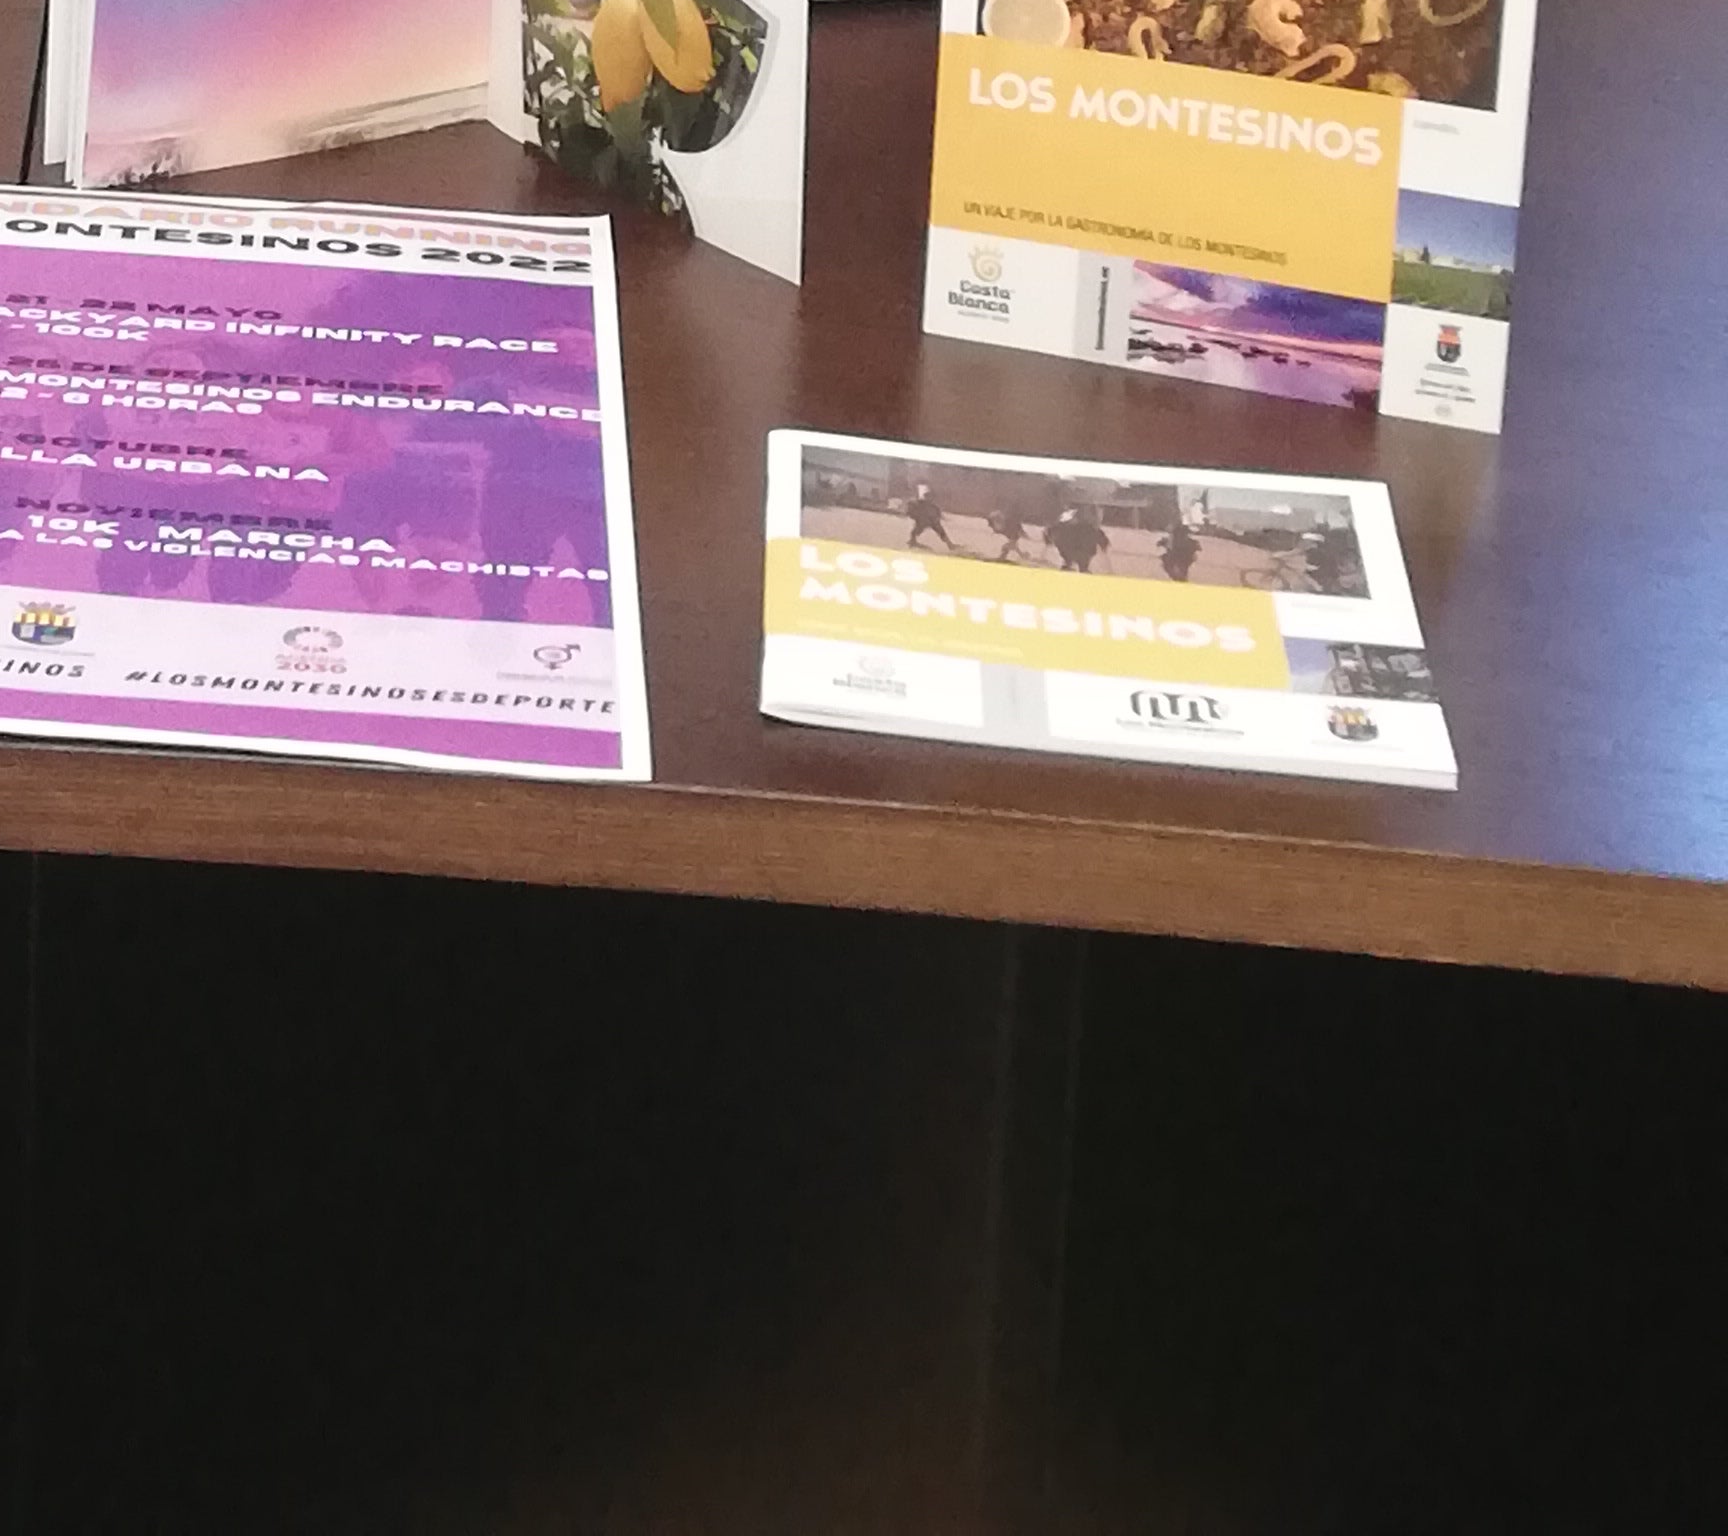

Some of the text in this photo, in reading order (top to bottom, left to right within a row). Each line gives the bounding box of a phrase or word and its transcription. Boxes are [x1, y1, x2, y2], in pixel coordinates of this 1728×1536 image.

[969, 68, 1383, 167] LOS MONTESINOS
[269, 216, 593, 256] RUNNING
[421, 246, 592, 274] 2022
[948, 290, 1010, 314] Blanca
[960, 279, 1010, 299] Costa
[147, 302, 283, 321] MAYO
[35, 321, 150, 343] 100K
[224, 321, 423, 346] INFINITY
[433, 334, 559, 354] RACE
[101, 393, 264, 416] HORAS
[311, 390, 604, 424] ENDURANCE
[15, 431, 250, 461] OCTUBRE
[113, 454, 331, 484] URBANA
[26, 513, 122, 536] 10K
[158, 524, 397, 554] MARCHA
[35, 531, 114, 550] LAS
[123, 540, 361, 567] VIOLENCIAS
[370, 554, 610, 582] MACHISTAS
[799, 543, 929, 584] LOS
[799, 576, 1257, 654] MONTESINOS
[125, 669, 617, 716] #LOSMONTESINOSESDEPORTE
